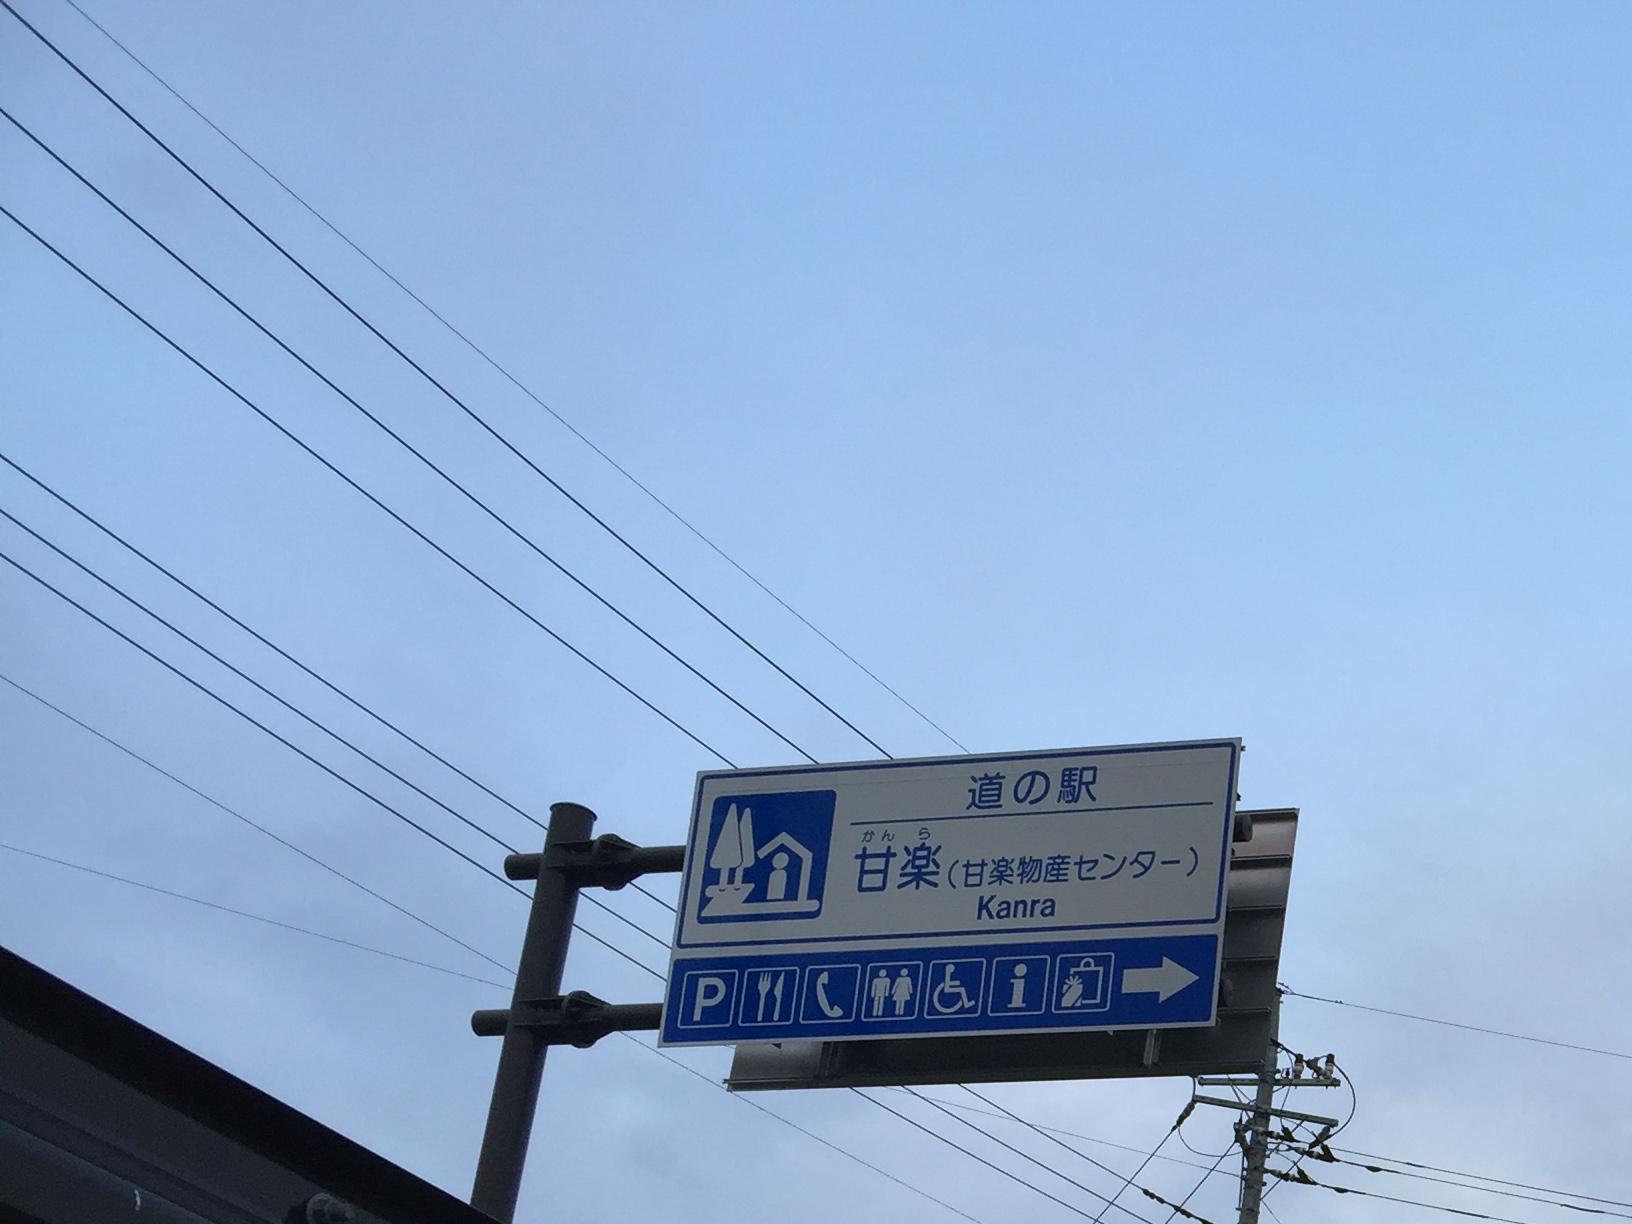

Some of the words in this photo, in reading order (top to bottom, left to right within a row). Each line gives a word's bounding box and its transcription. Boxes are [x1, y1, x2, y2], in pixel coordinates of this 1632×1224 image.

[965, 765, 1098, 810] 道の駅
[976, 895, 1056, 921] Kanra
